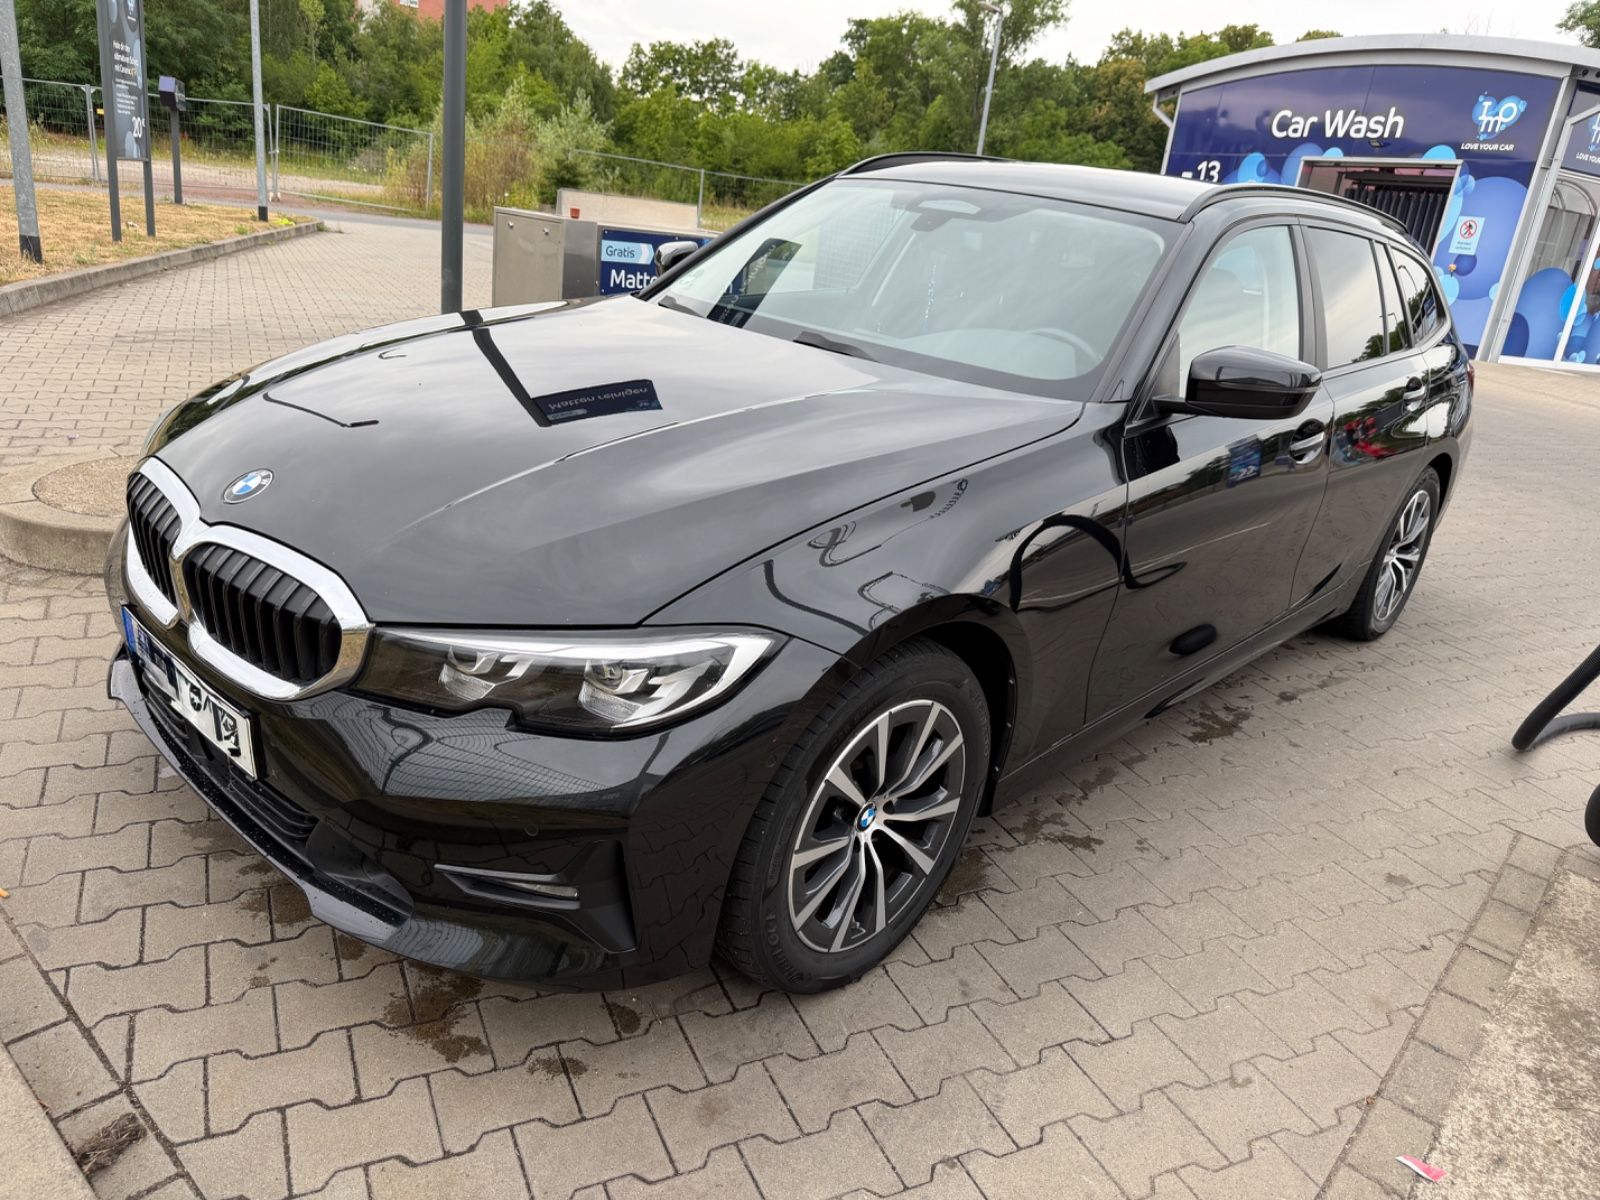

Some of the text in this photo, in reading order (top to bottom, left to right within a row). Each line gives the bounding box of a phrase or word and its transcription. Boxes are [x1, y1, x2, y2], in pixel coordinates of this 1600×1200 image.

[1271, 106, 1405, 139] Car Wash
[1460, 142, 1515, 151] LOVE YOUR CAR
[605, 245, 636, 259] Gratis
